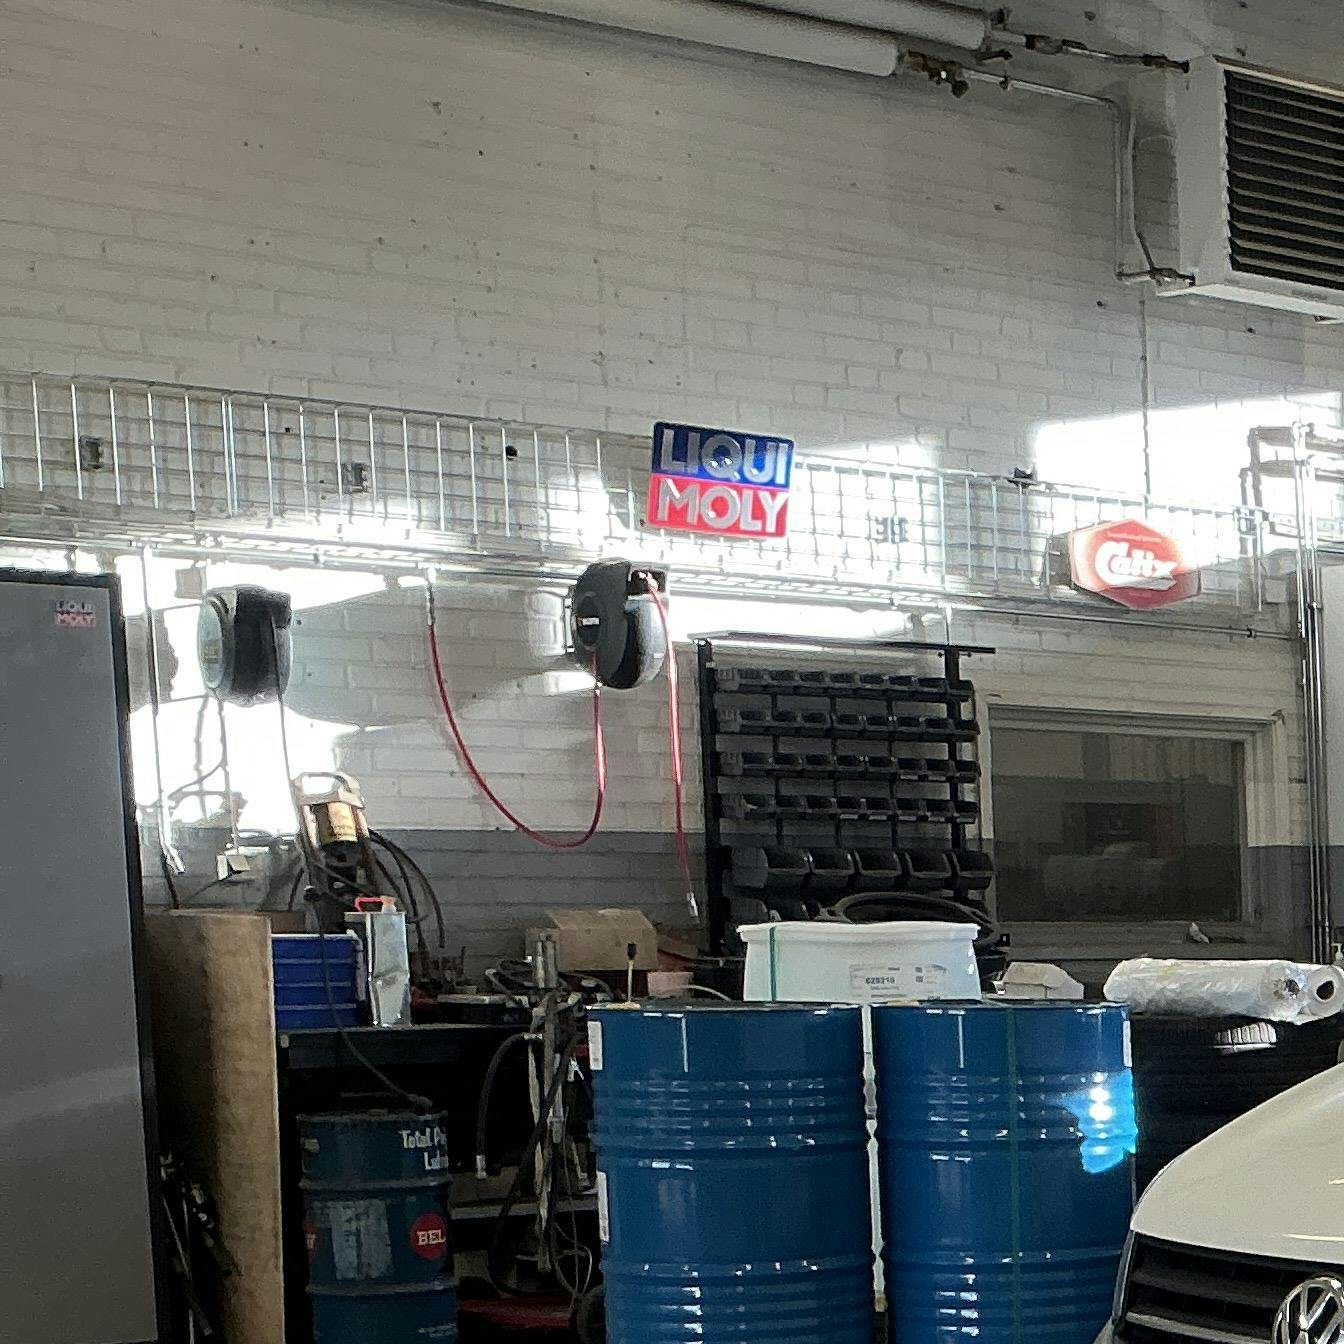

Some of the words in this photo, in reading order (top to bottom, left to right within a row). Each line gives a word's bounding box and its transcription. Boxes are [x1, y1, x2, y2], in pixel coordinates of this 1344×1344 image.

[660, 428, 789, 485] LIQUI
[656, 477, 789, 533] MOLY
[399, 1127, 433, 1149] Total
